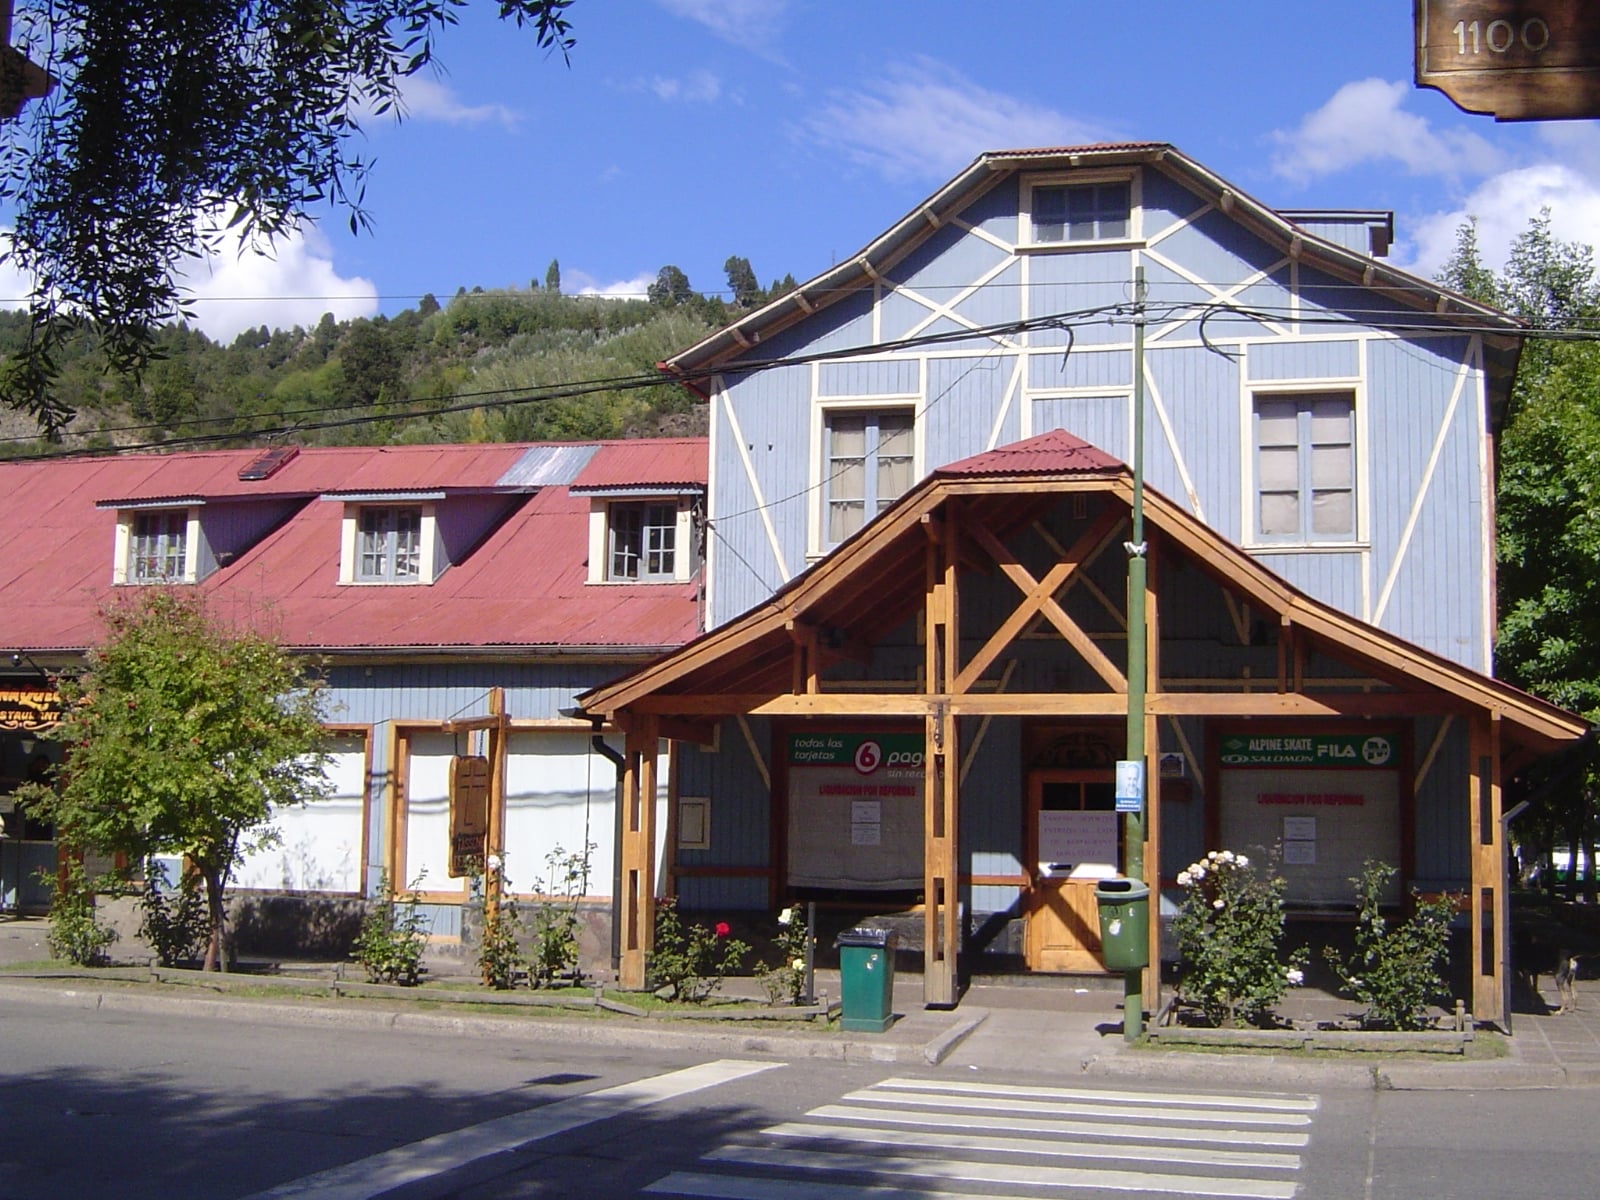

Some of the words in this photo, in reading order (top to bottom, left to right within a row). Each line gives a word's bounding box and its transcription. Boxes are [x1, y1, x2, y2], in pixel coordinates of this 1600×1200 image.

[1453, 17, 1549, 54] 1100
[795, 738, 824, 748] todas
[828, 738, 843, 748] las
[1249, 738, 1282, 751] ALPINE
[1284, 738, 1313, 751] SKATE
[795, 751, 836, 762] tarjetas
[859, 745, 875, 766] 6
[1317, 745, 1356, 758] FILA
[1250, 755, 1314, 763] SALOMON
